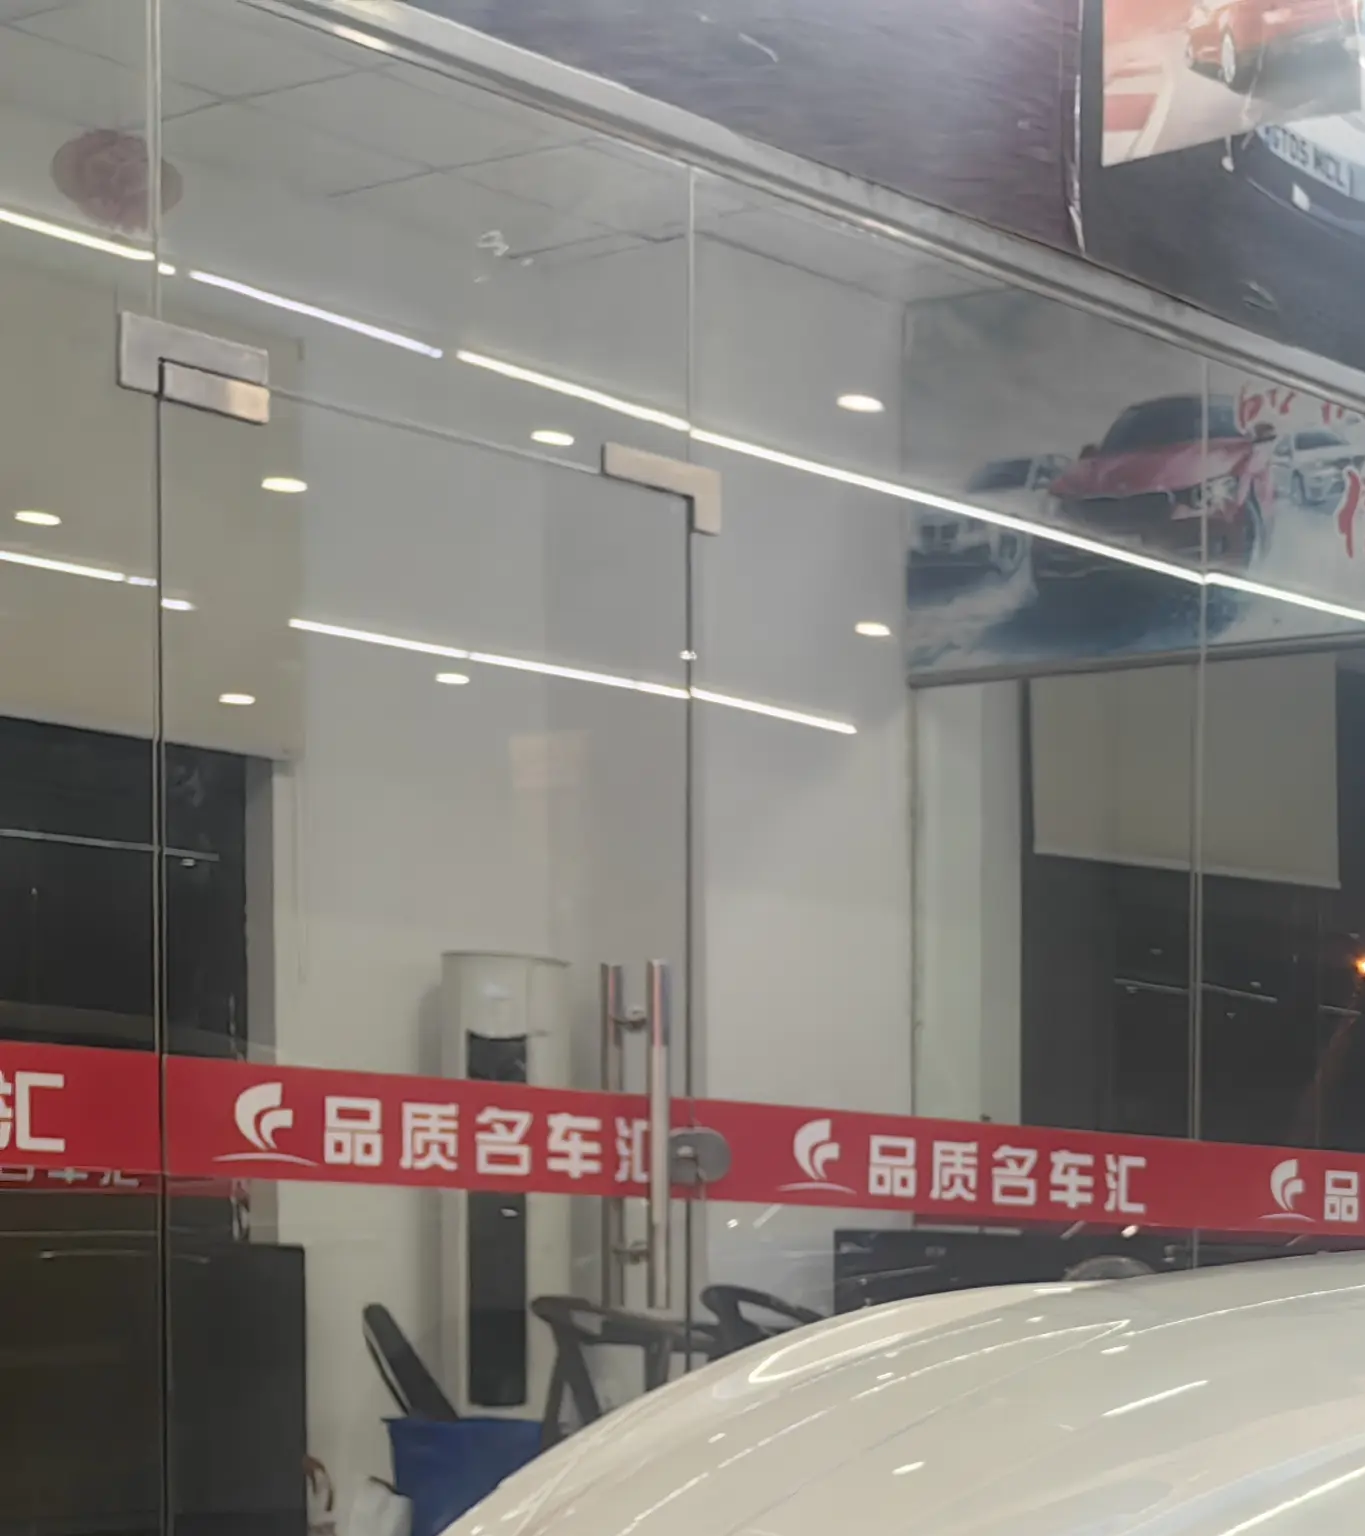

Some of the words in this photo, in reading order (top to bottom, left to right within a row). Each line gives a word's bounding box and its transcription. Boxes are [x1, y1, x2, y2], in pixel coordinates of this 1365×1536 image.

[323, 1095, 651, 1185] 品质名车汇
[868, 1134, 1147, 1214] 品质名车汇
